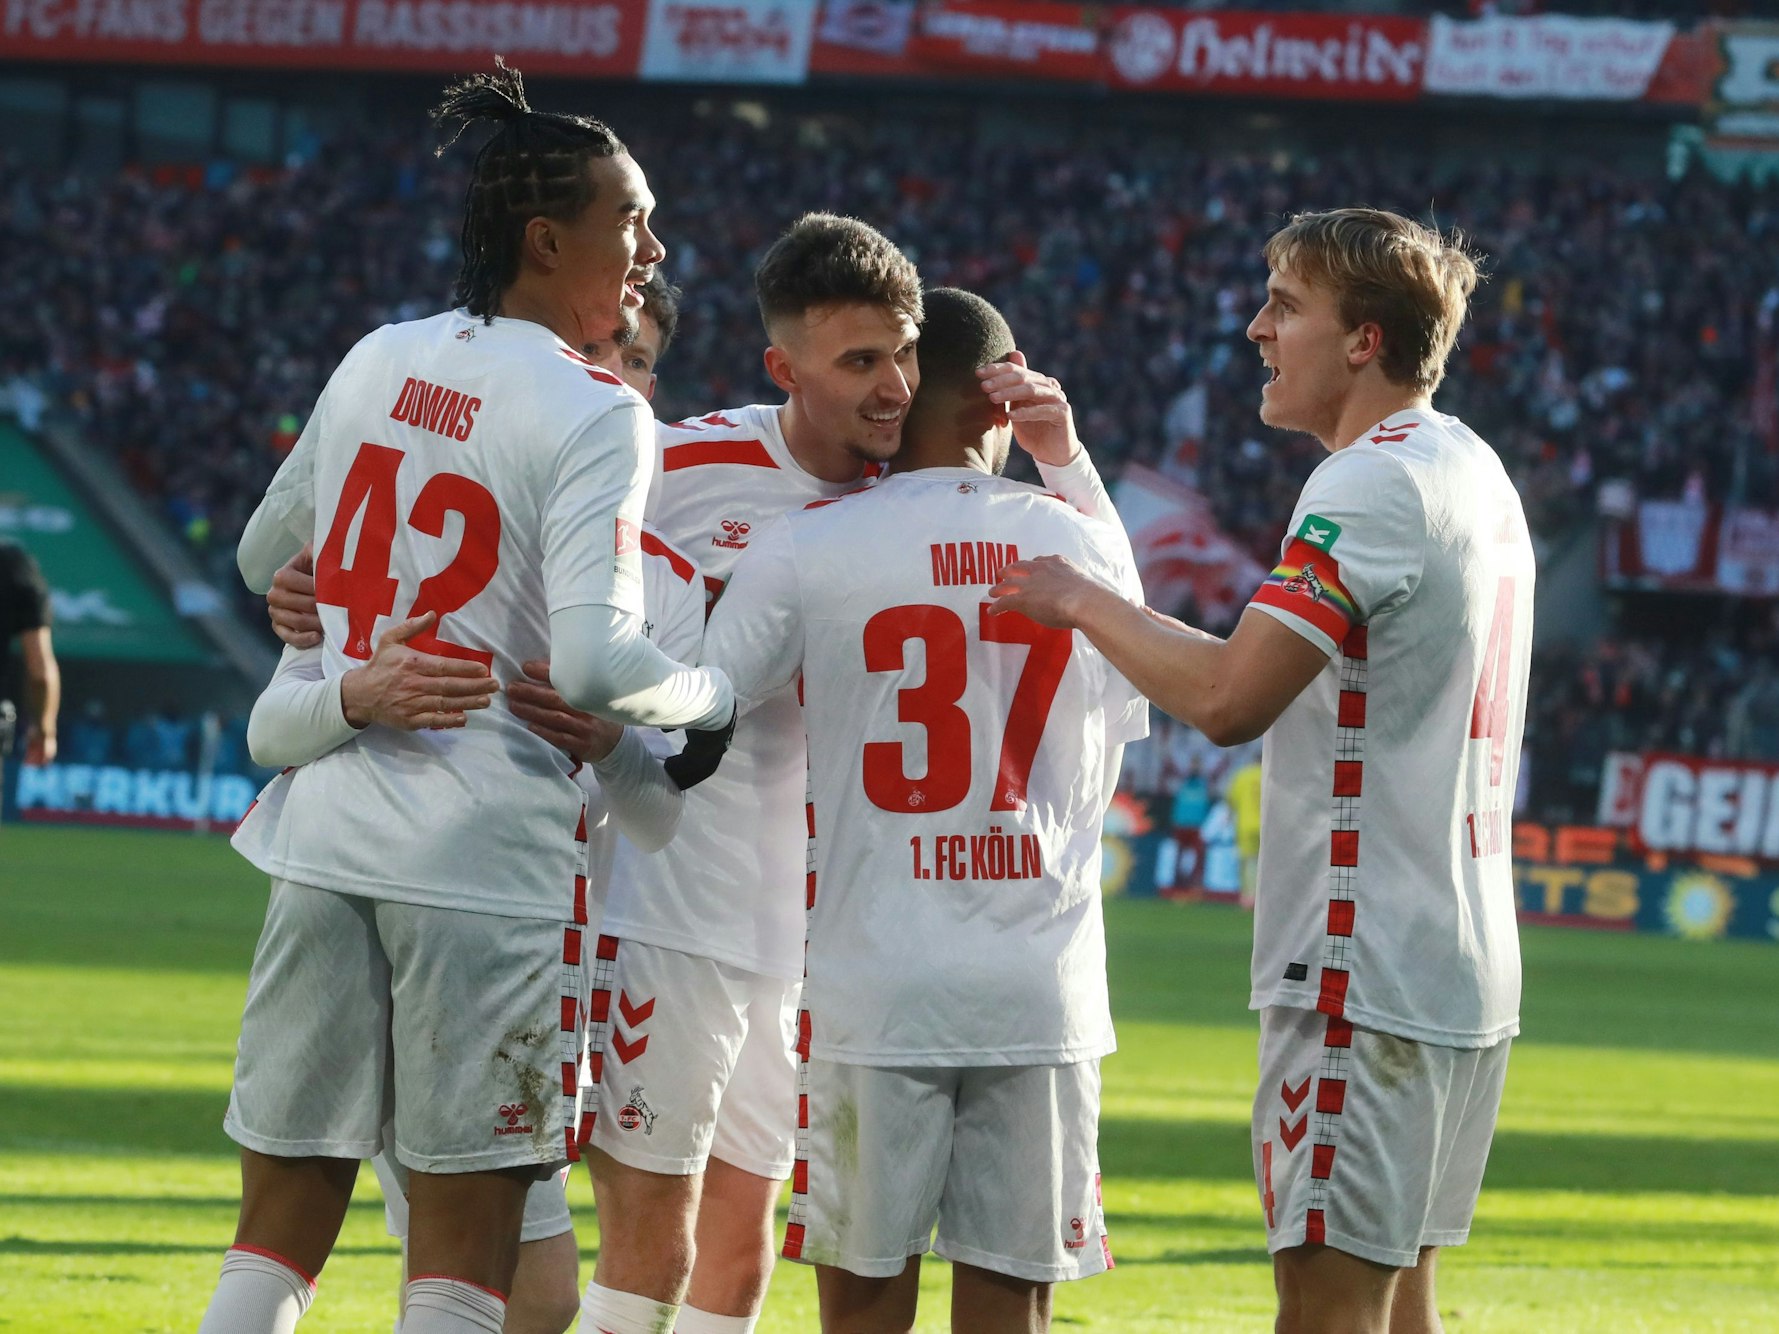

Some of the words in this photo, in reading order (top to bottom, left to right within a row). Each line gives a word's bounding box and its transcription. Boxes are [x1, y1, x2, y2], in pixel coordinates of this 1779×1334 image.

[201, 0, 344, 46] GEGEN
[354, 0, 622, 56] RASSISMUS
[389, 377, 482, 442] DOWNS
[315, 442, 501, 678] 42
[863, 603, 1073, 813] 37
[1470, 576, 1516, 787] 4
[15, 763, 257, 820] MERKUR
[971, 828, 1042, 880] KÖLN
[494, 1125, 533, 1136] hummel
